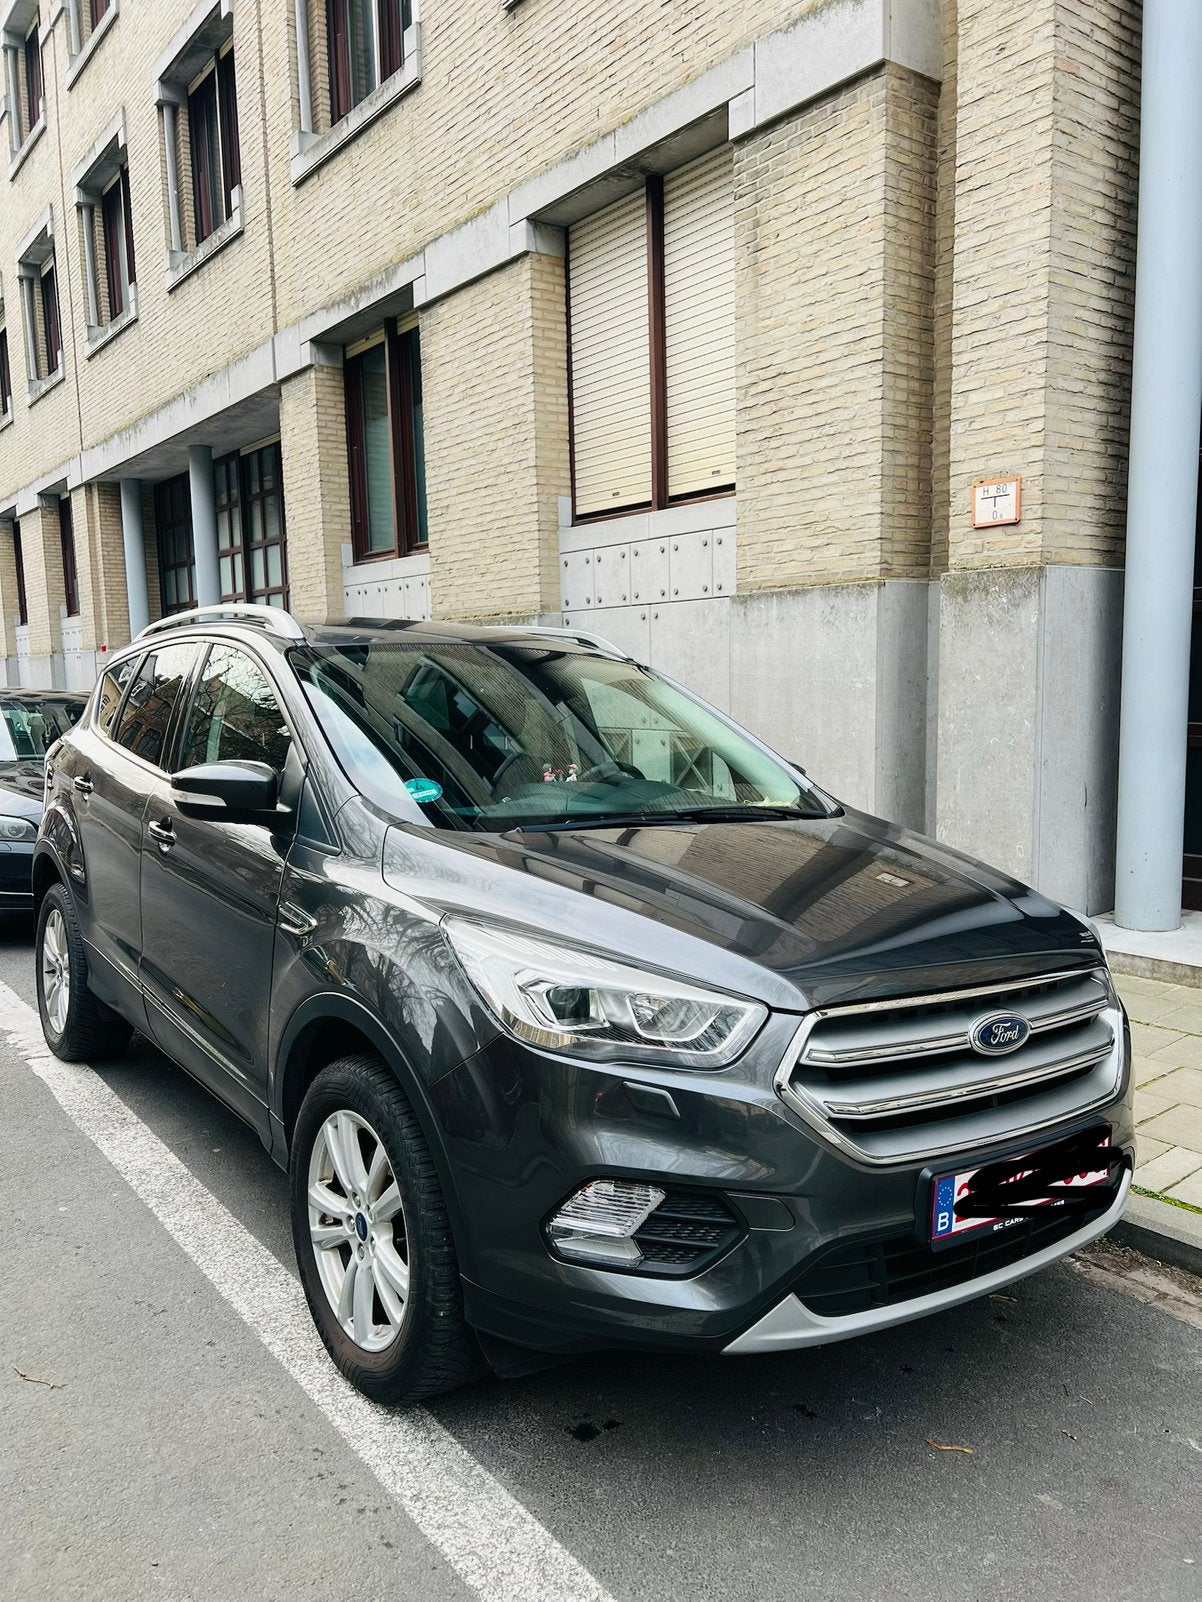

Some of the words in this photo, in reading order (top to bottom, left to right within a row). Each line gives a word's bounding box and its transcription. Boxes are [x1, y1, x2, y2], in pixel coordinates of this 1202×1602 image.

[982, 487, 989, 496] H
[995, 484, 1008, 493] 80
[991, 1022, 1019, 1044] Ford
[938, 1212, 949, 1231] B
